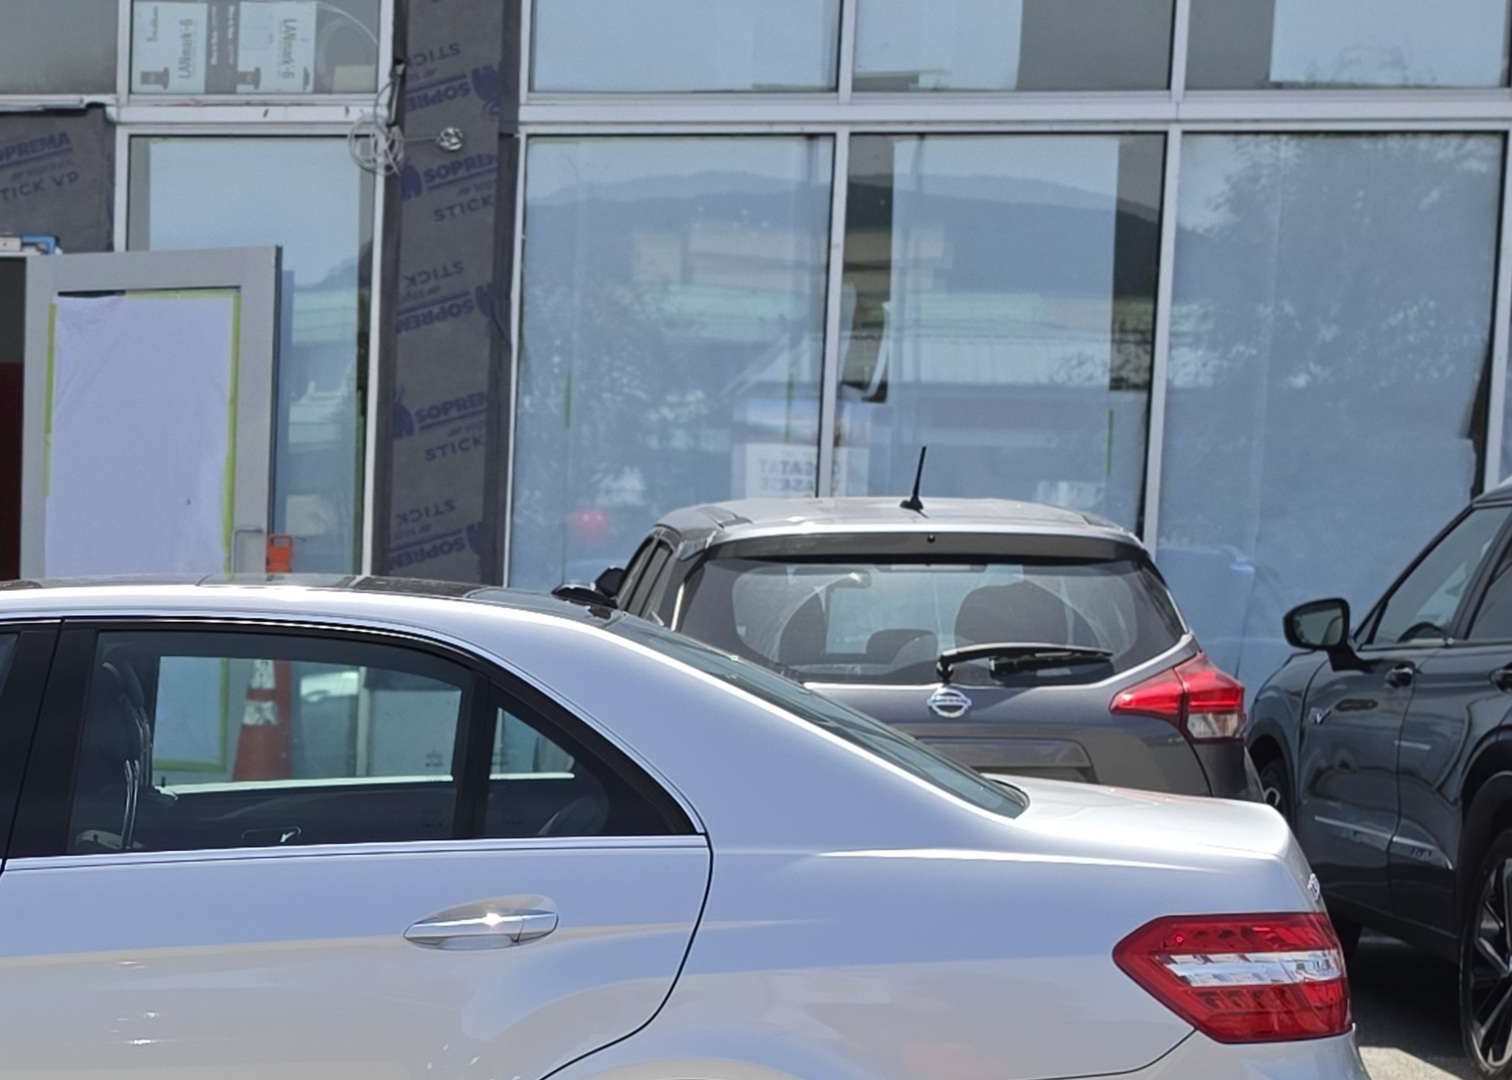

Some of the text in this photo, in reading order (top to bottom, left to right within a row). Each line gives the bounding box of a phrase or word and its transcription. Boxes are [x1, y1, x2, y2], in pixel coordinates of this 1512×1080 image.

[407, 42, 462, 66] STIC
[53, 170, 80, 188] VP
[433, 193, 494, 222] STICK
[402, 259, 464, 286] STICK
[424, 434, 486, 461] STICK
[396, 499, 457, 524] STICK
